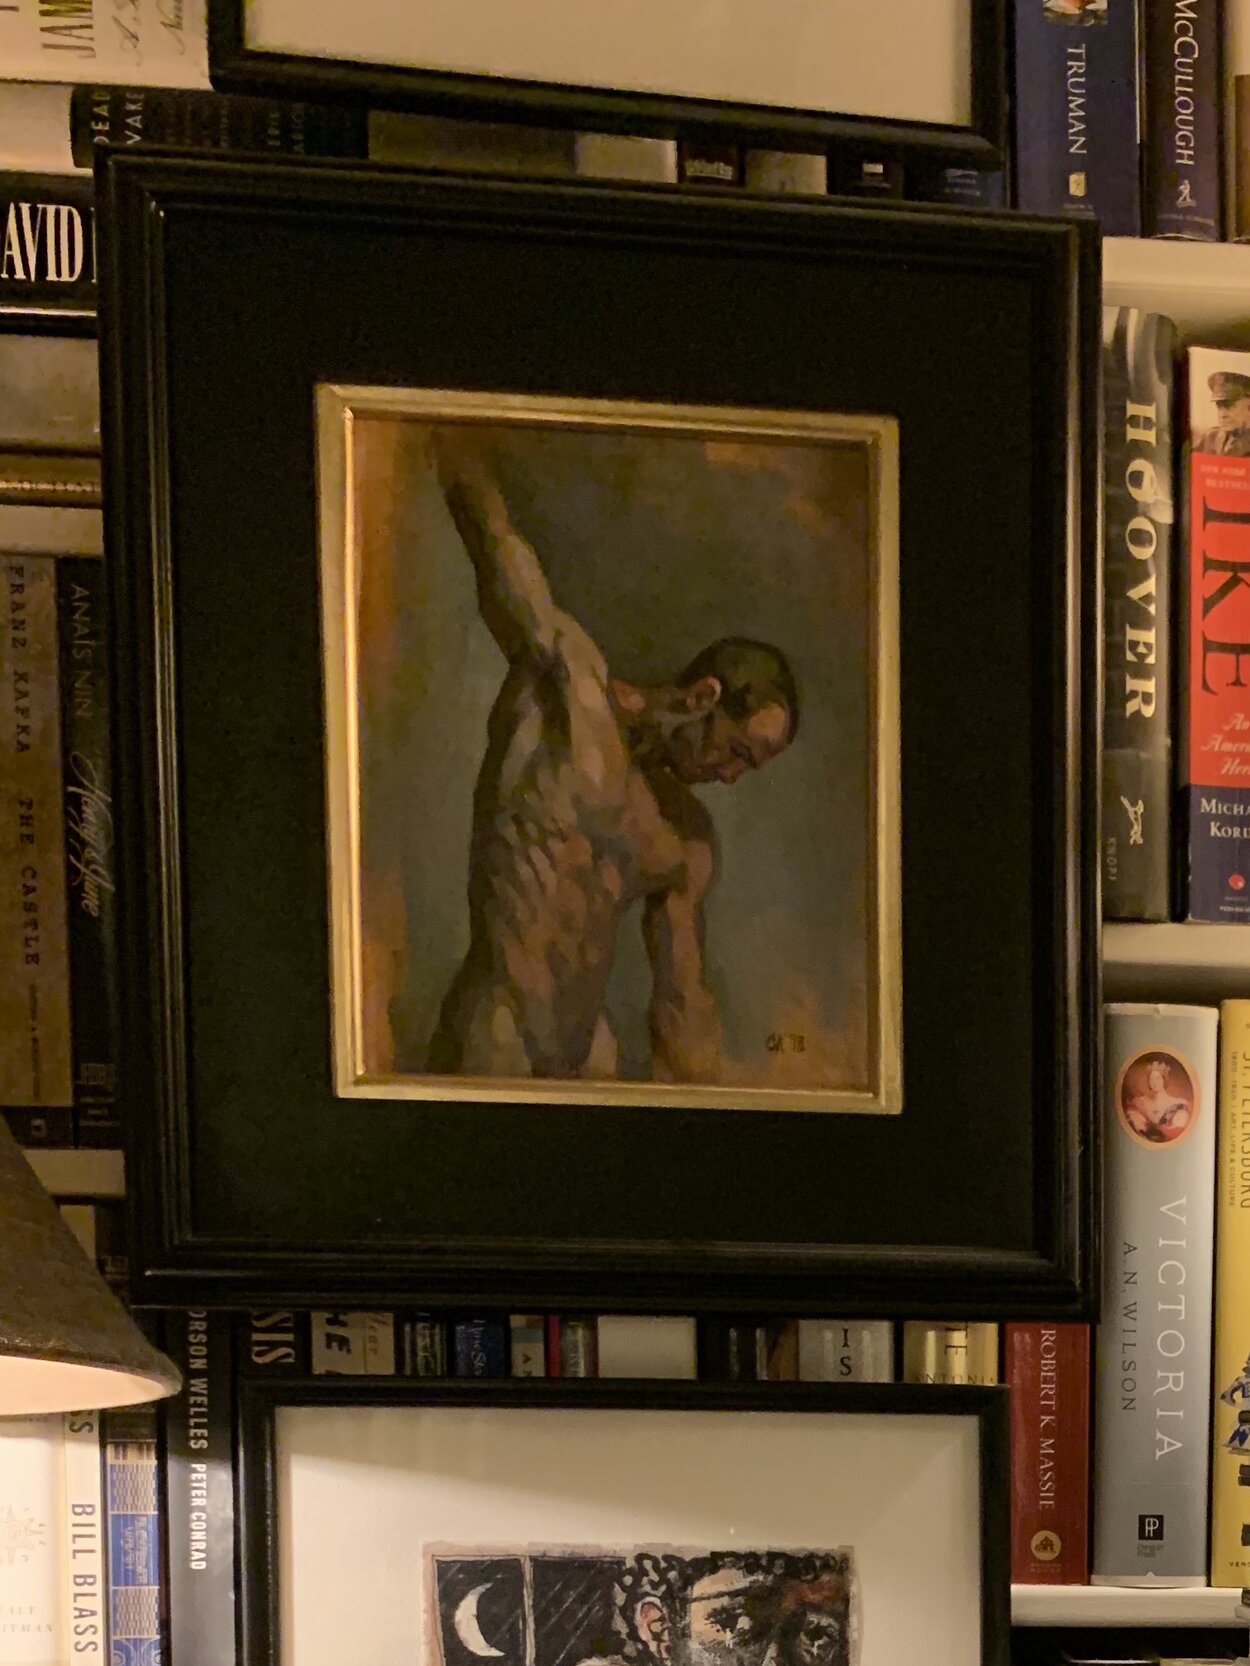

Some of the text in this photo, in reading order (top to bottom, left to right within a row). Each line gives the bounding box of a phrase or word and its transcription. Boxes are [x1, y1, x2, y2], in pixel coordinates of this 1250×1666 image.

[1066, 42, 1088, 155] TRUMAN
[9, 564, 28, 650] FRANZ
[1124, 400, 1158, 719] HOOVER
[13, 667, 32, 753] KAFKA
[18, 796, 34, 846] THE
[20, 865, 41, 968] CASTLE
[1121, 1301, 1138, 1412] WILSON
[1155, 1195, 1187, 1461] VICTORIA
[188, 1378, 210, 1450] WELLES
[1039, 1329, 1057, 1510] ROBERT MASSIE
[188, 1463, 208, 1506] PETER
[71, 1503, 99, 1654] BILL BLASS
[188, 1512, 208, 1571] CONRAD
